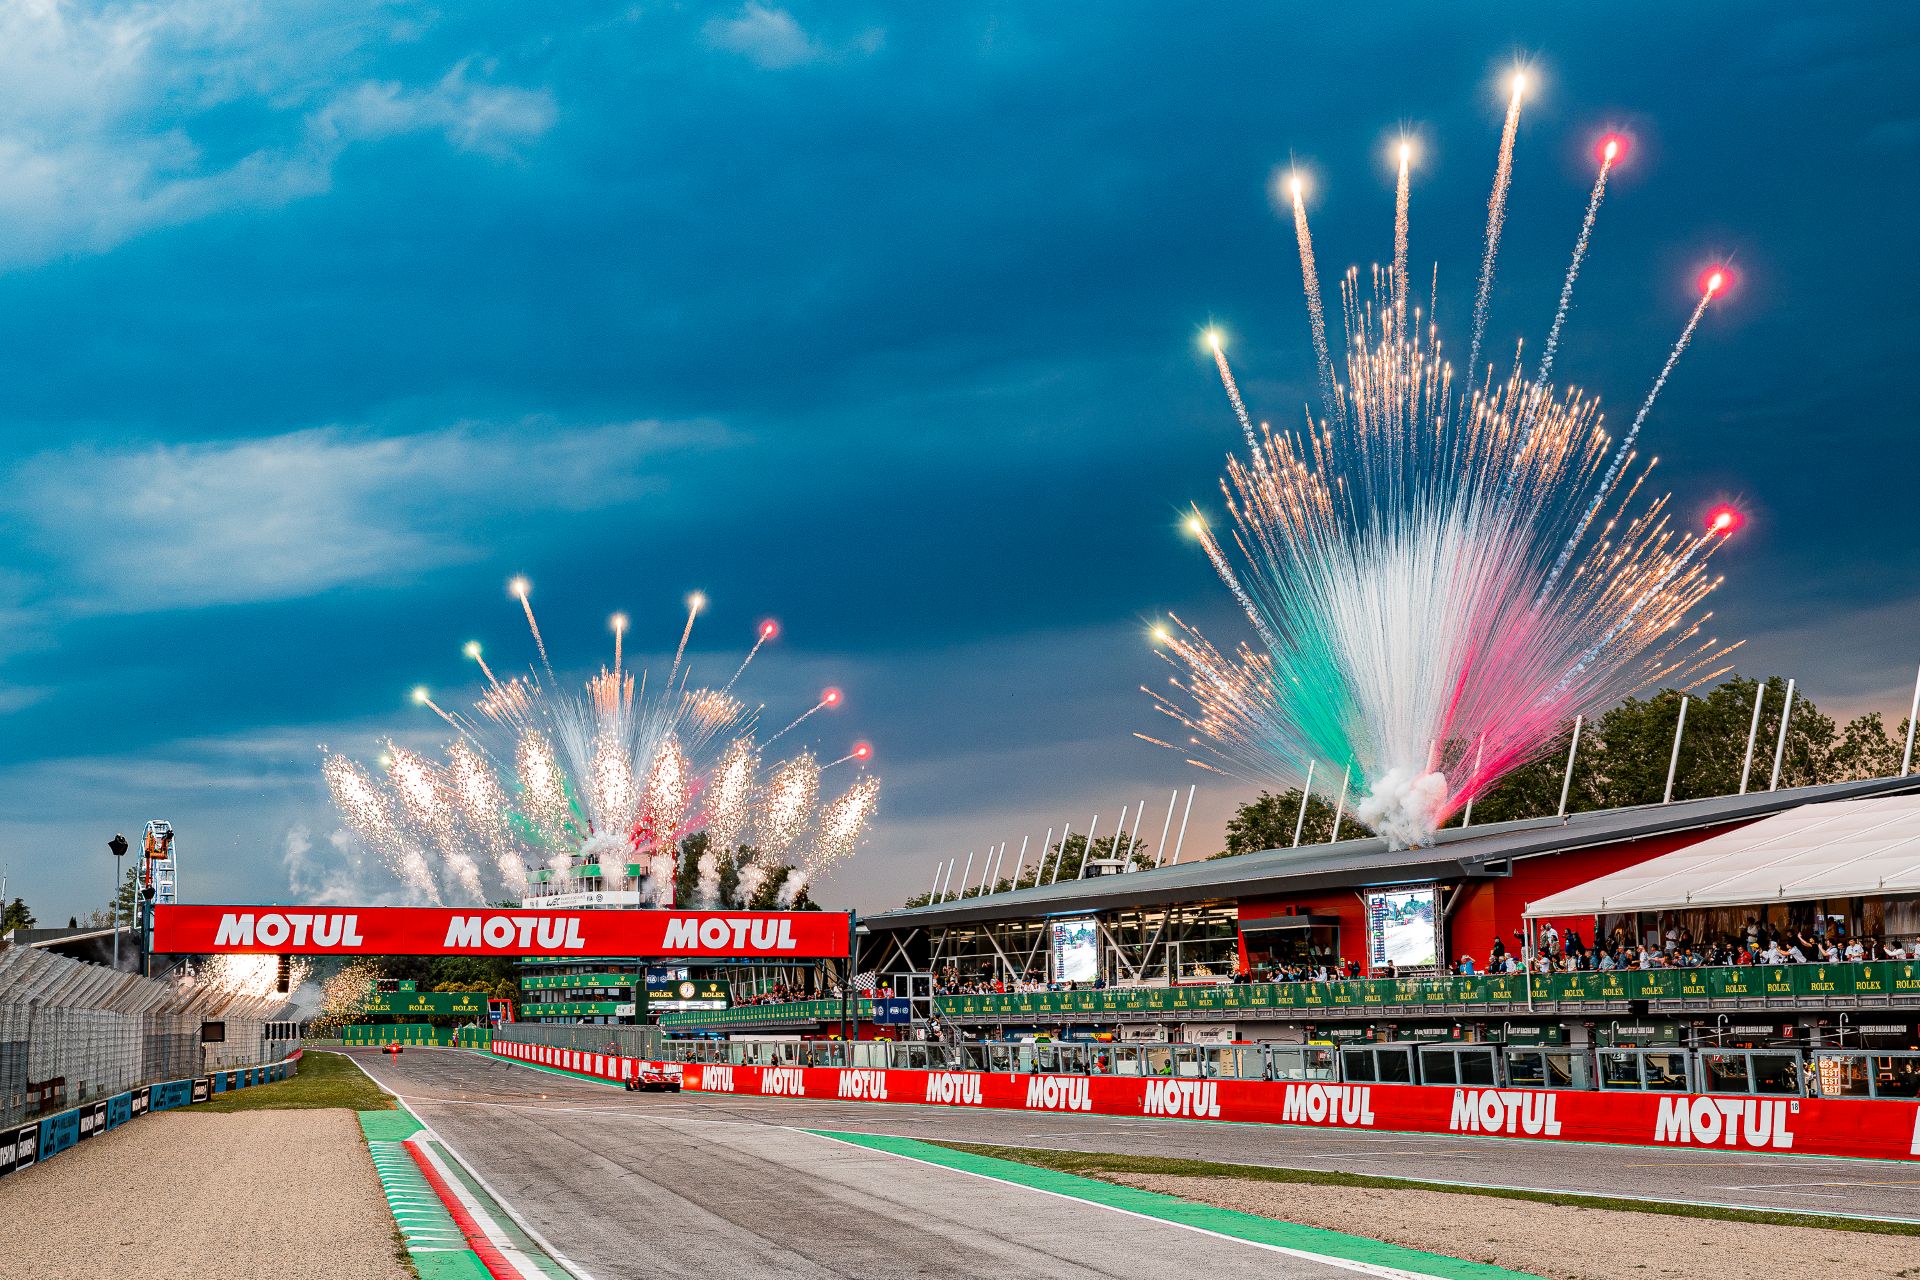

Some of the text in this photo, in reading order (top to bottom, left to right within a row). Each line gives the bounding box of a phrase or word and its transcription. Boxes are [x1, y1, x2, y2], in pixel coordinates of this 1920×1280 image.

[214, 914, 364, 946] MOTUL
[444, 916, 585, 948] MOTUL
[662, 918, 796, 949] MOTUL
[1427, 993, 1444, 1001] ROLEX
[1564, 989, 1584, 997] ROLEX
[1642, 987, 1664, 995] ROLEX
[1683, 986, 1705, 994] ROLEX
[1726, 984, 1748, 992] ROLEX
[1768, 983, 1790, 991] ROLEX
[1811, 982, 1835, 990] ROLEX
[1856, 981, 1881, 990] ROLEX
[1306, 996, 1322, 1004] ROLEX
[1784, 1027, 1791, 1035] 17
[702, 1066, 734, 1091] MOTUL
[762, 1067, 805, 1095] MOTUL
[838, 1070, 887, 1099] MOTUL
[926, 1073, 982, 1104] MOTUL
[1026, 1076, 1092, 1110] MOTUL
[1144, 1079, 1220, 1117] MOTUL
[1282, 1084, 1375, 1125] MOTUL
[1450, 1089, 1562, 1136] MOTUL
[1791, 1102, 1799, 1111] 18
[1654, 1096, 1794, 1148] MOTUL
